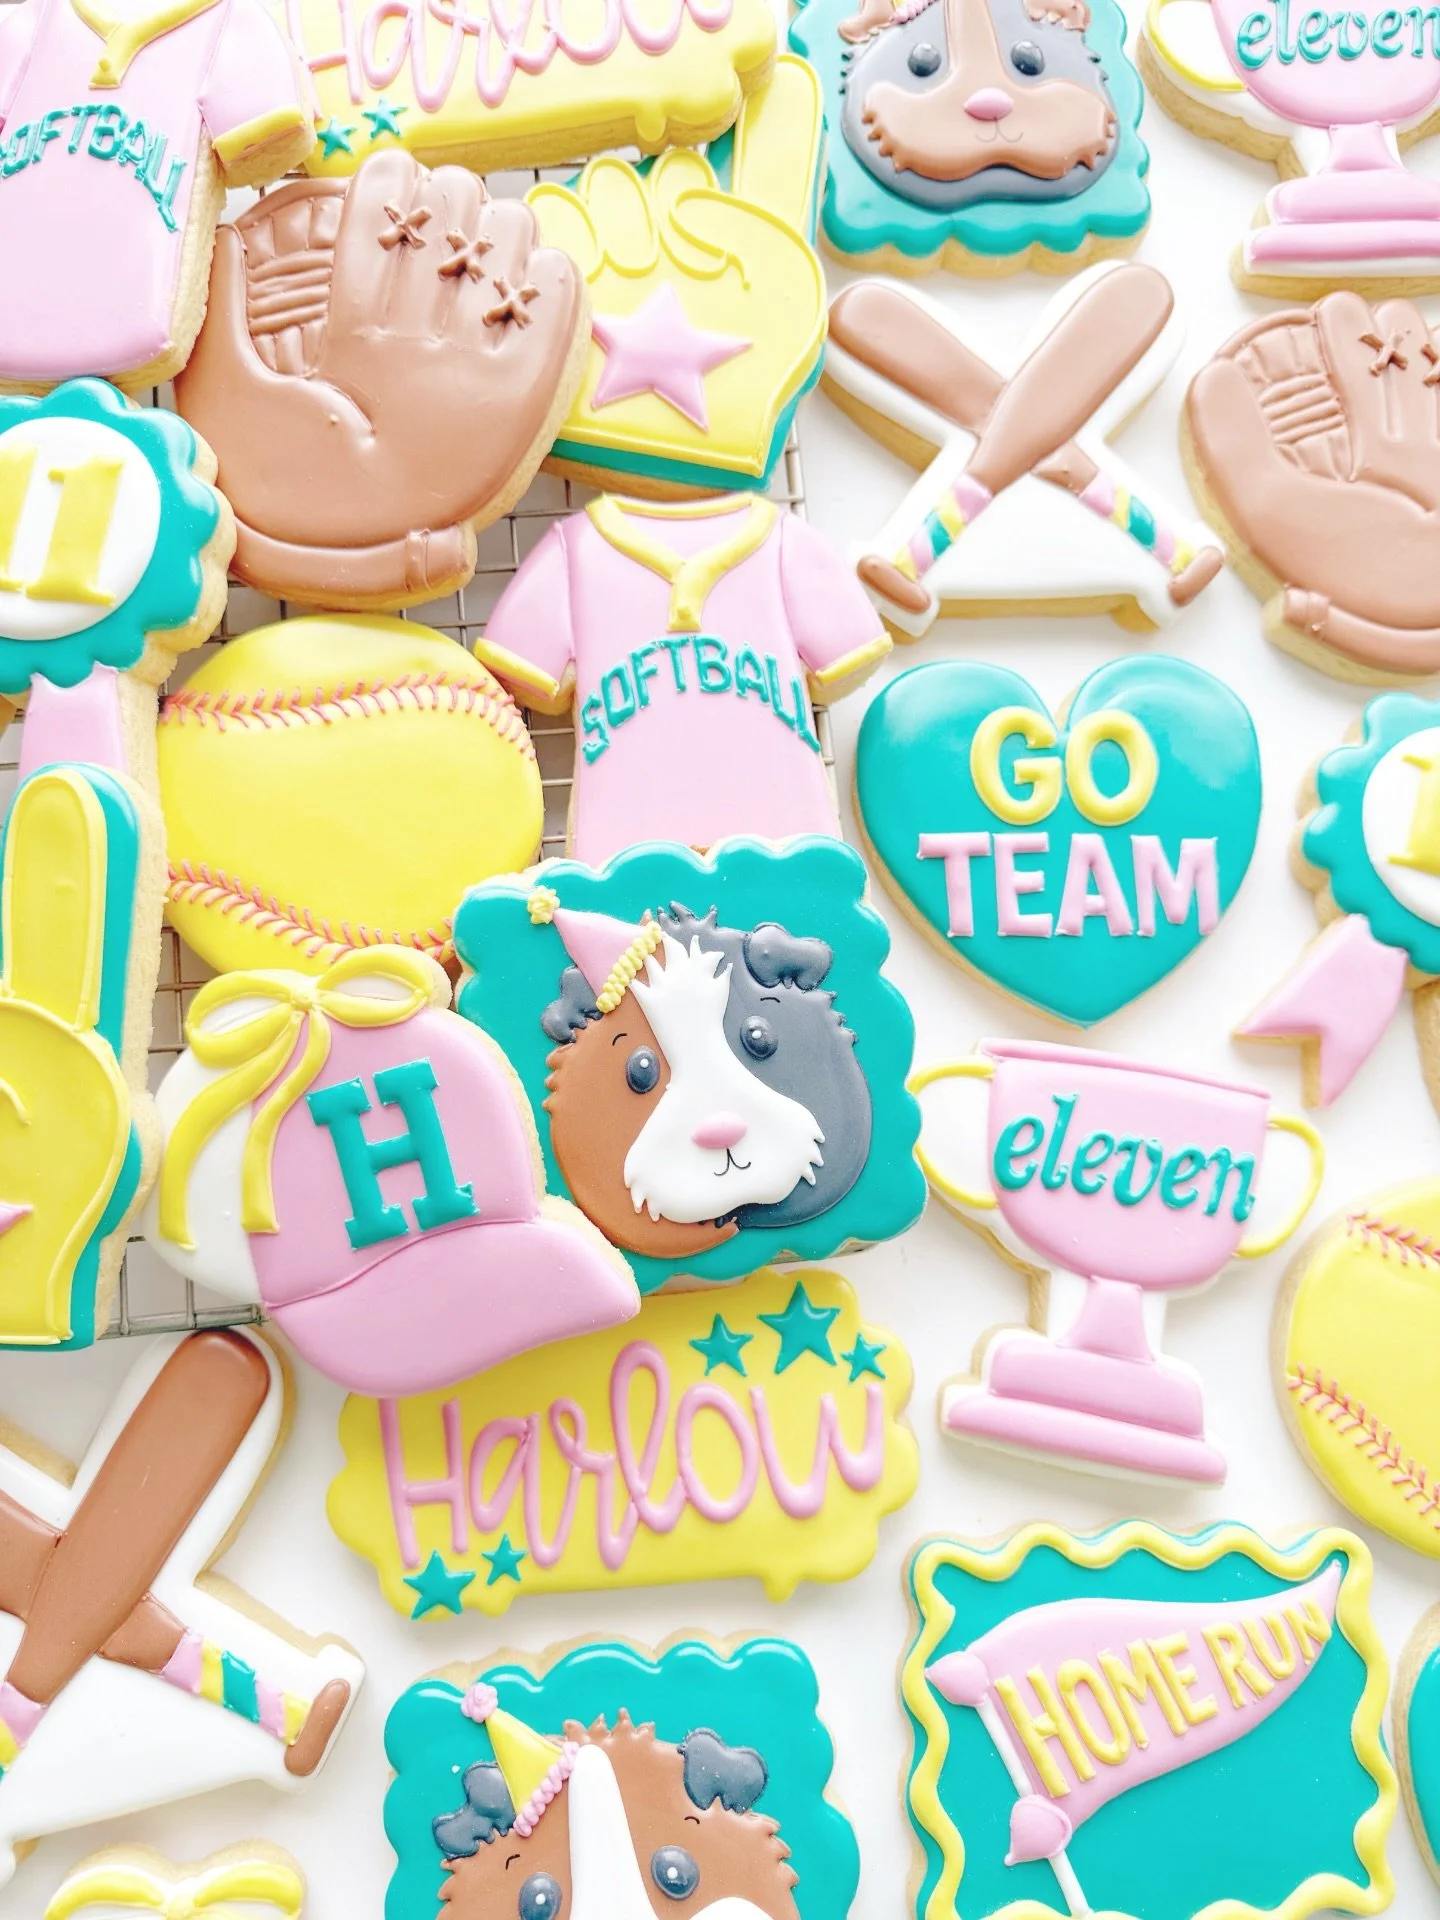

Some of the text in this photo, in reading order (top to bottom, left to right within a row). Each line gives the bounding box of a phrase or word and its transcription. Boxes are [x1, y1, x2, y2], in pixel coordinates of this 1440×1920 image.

[1236, 0, 1440, 70] eleven
[581, 635, 821, 765] SOFTBALL
[970, 706, 1159, 826] GO
[916, 832, 1219, 938] TEAM
[306, 1057, 480, 1250] H
[994, 1090, 1256, 1222] eleven
[378, 1340, 885, 1570] Harlow
[994, 1596, 1332, 1798] HOME RUN
